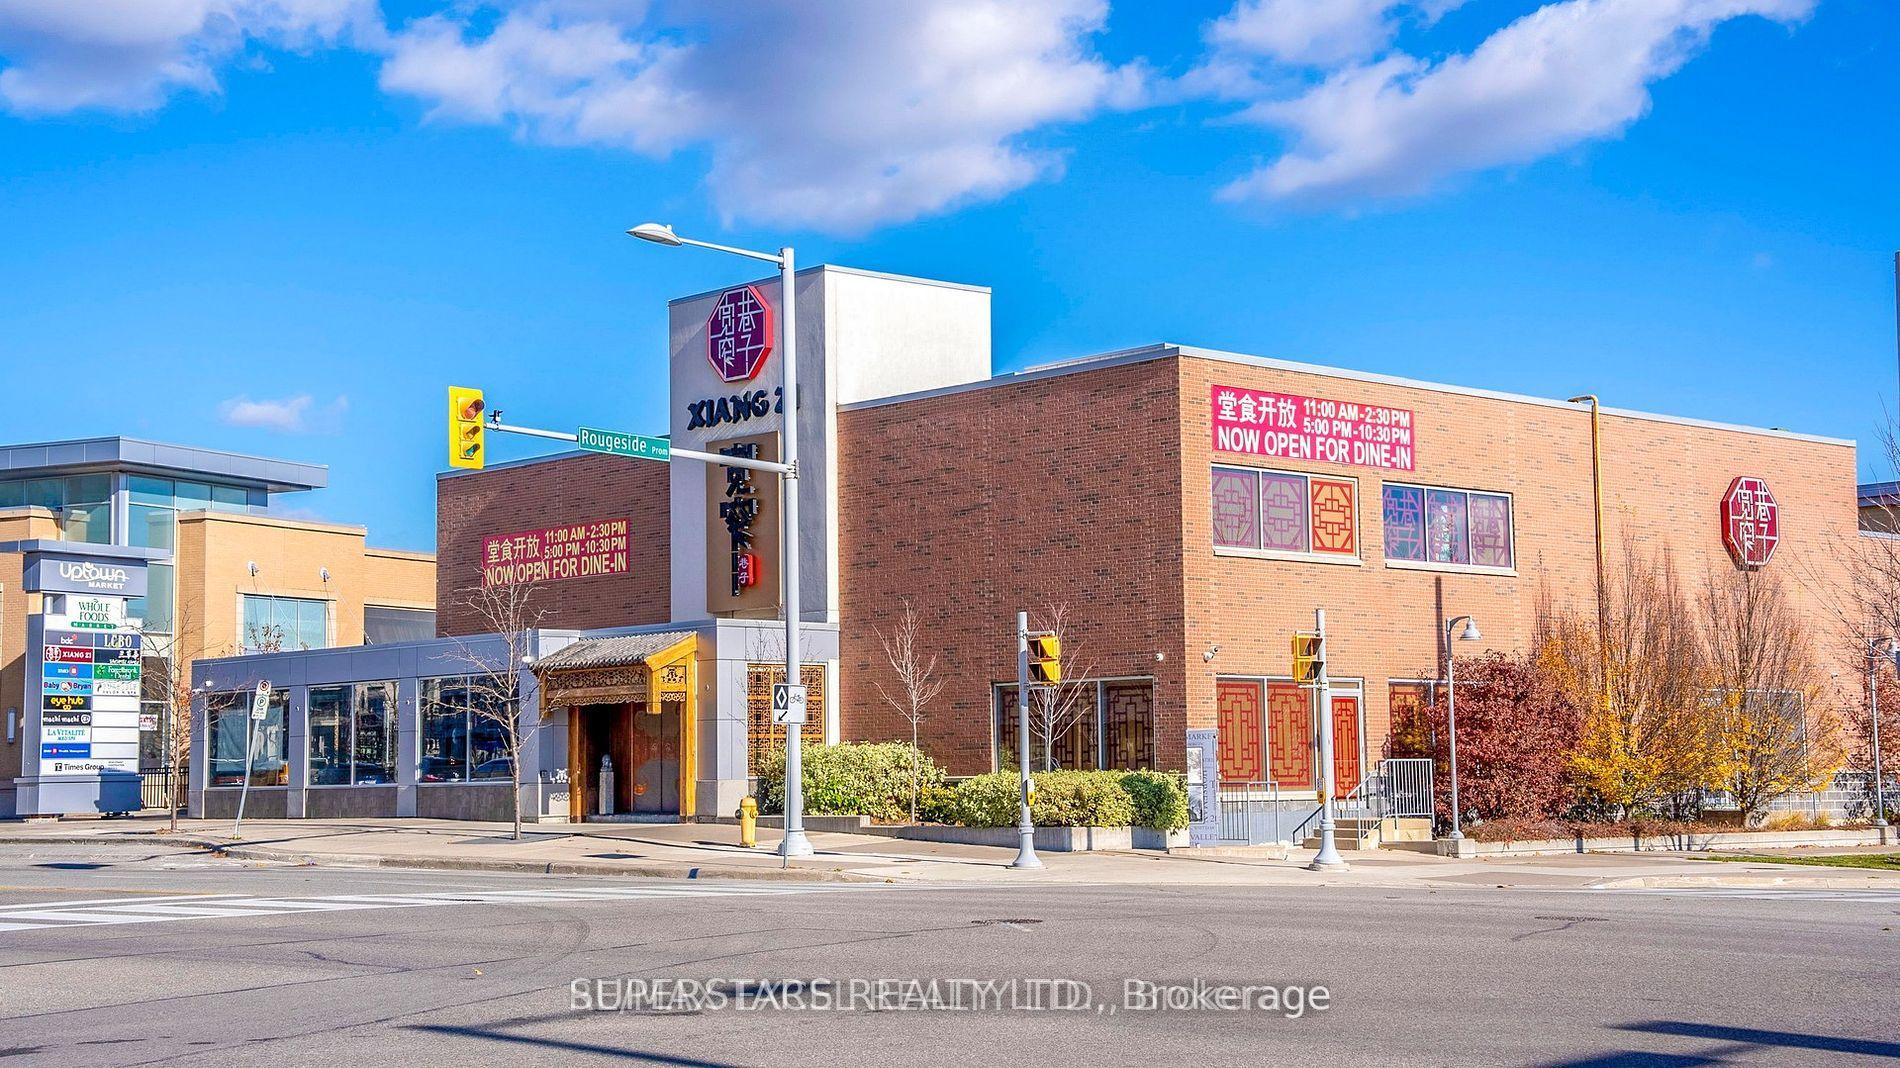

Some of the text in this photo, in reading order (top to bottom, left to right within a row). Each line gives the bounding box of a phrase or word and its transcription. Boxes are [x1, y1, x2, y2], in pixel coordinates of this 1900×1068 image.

[687, 390, 769, 430] XIANG
[1218, 391, 1297, 428] 堂食开放
[1303, 399, 1335, 418] 11:00
[1391, 411, 1410, 427] PM
[1303, 417, 1329, 435] 5:00
[1392, 427, 1410, 445] PM
[581, 430, 667, 455] Rougeside Prom
[1218, 426, 1411, 469] NOW OPEN FOR DINE-IN
[545, 529, 567, 543] 11:00
[611, 521, 626, 535] PM
[487, 535, 540, 563] 堂食开放
[544, 544, 562, 559] 5:00
[611, 536, 626, 551] PM
[486, 552, 626, 587] NOW OPEN FOR DINE-IN
[88, 582, 124, 590] MARKET
[78, 601, 110, 612] WHOLE
[80, 611, 109, 621] FOODS
[60, 636, 74, 645] bdc
[104, 634, 132, 648] LCBO
[43, 682, 60, 690] Baby
[73, 682, 92, 691] Bryan
[50, 697, 84, 706] eye hub
[85, 763, 104, 772] Group
